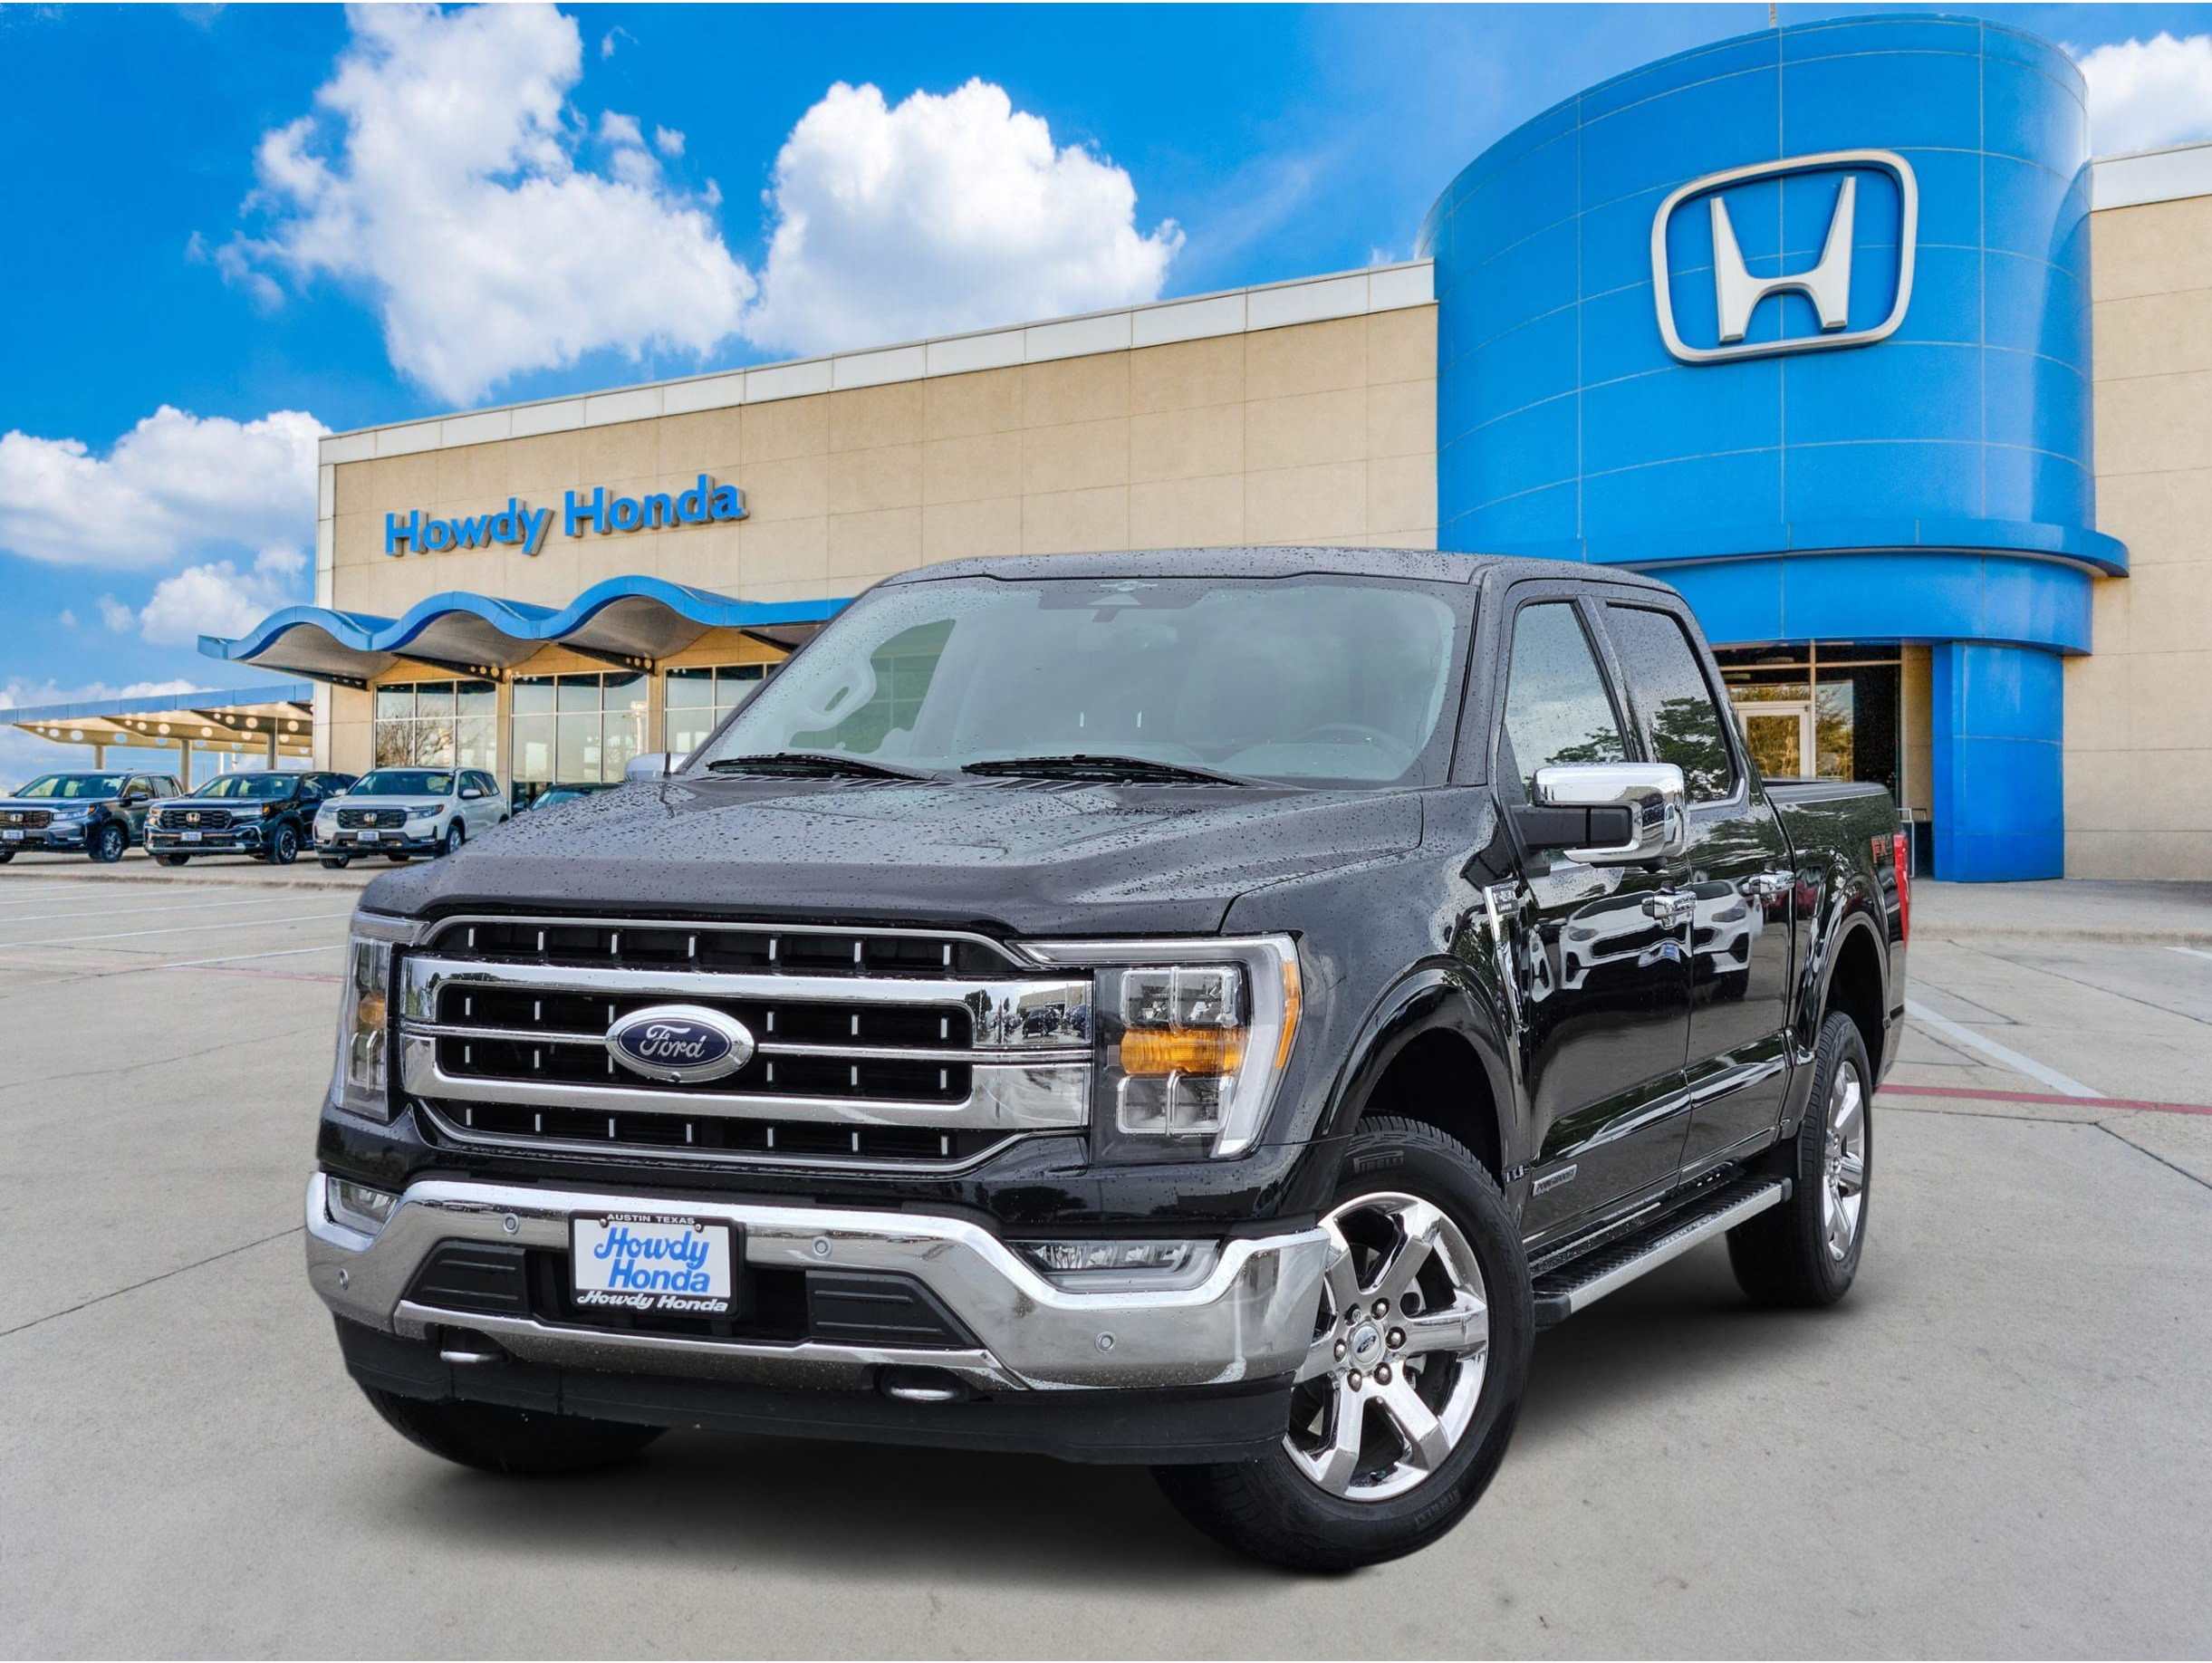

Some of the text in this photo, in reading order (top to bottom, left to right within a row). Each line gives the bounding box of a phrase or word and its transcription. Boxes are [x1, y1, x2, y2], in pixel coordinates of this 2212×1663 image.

[385, 474, 748, 557] Howdy Honda
[640, 1024, 707, 1058] Ford
[607, 1213, 696, 1225] AUSTIN TEXAS
[593, 1227, 711, 1270] Howdy
[608, 1258, 711, 1293] Honda
[577, 1291, 728, 1312] Howdy Honda
